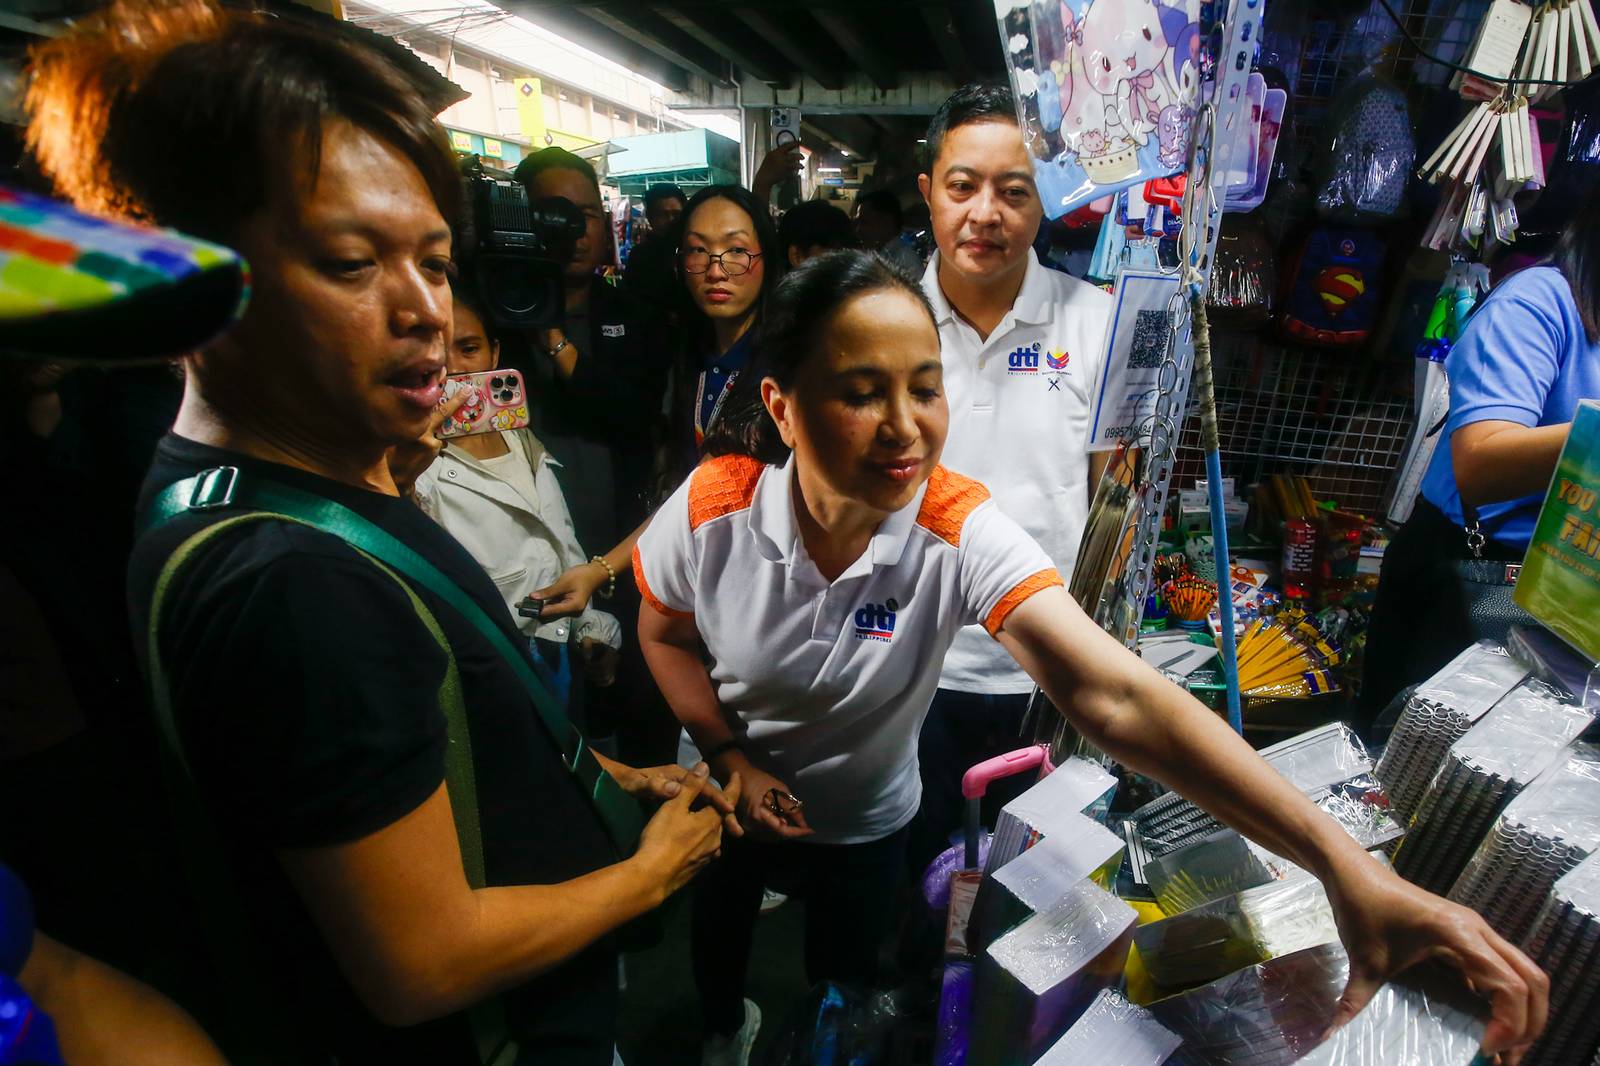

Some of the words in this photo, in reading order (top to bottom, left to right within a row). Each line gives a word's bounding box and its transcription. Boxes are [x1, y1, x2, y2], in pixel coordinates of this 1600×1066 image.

[1008, 342, 1041, 367] dti
[1558, 479, 1596, 512] YOU
[854, 598, 898, 632] dti
